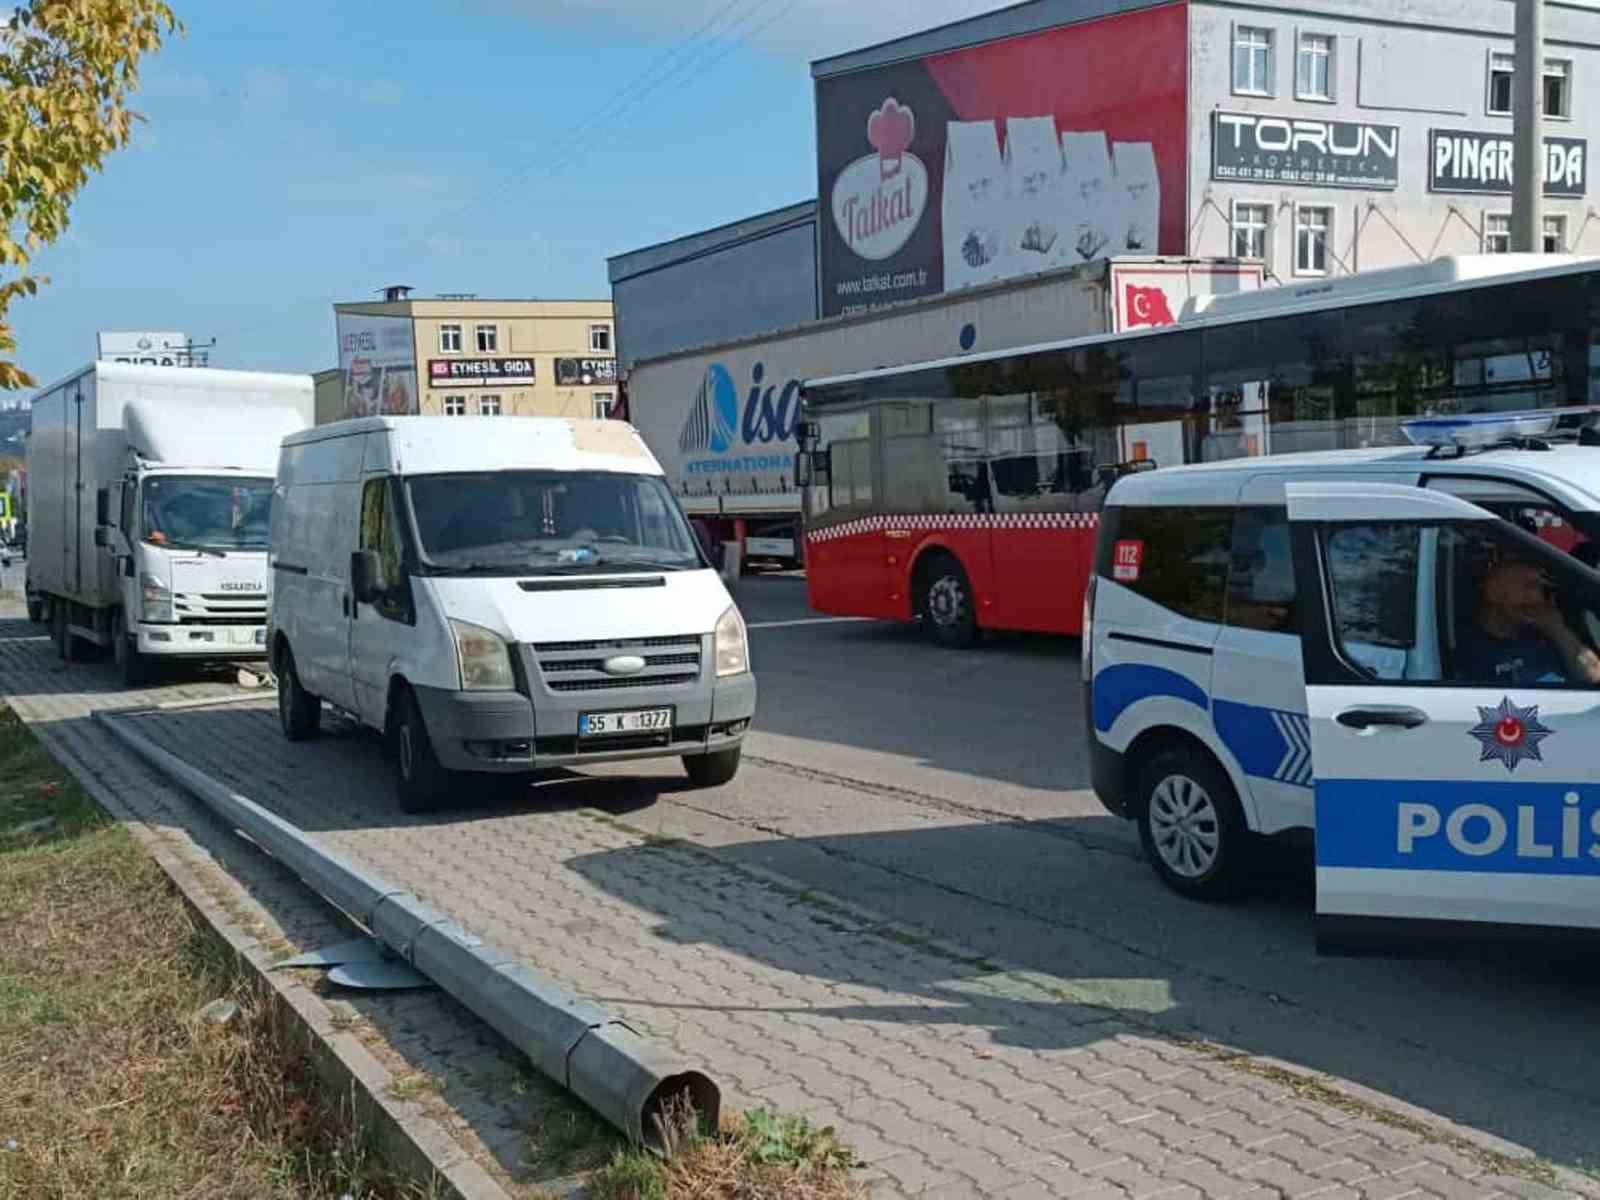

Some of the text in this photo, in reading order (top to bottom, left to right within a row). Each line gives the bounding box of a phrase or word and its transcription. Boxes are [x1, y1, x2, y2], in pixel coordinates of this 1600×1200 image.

[1219, 114, 1397, 158] TORUN
[1436, 136, 1584, 188] PINAR IDA
[504, 360, 532, 373] GIDA
[1119, 545, 1137, 564] 112
[221, 581, 262, 591] ISUZU
[589, 716, 605, 731] 55
[640, 711, 669, 728] 1377
